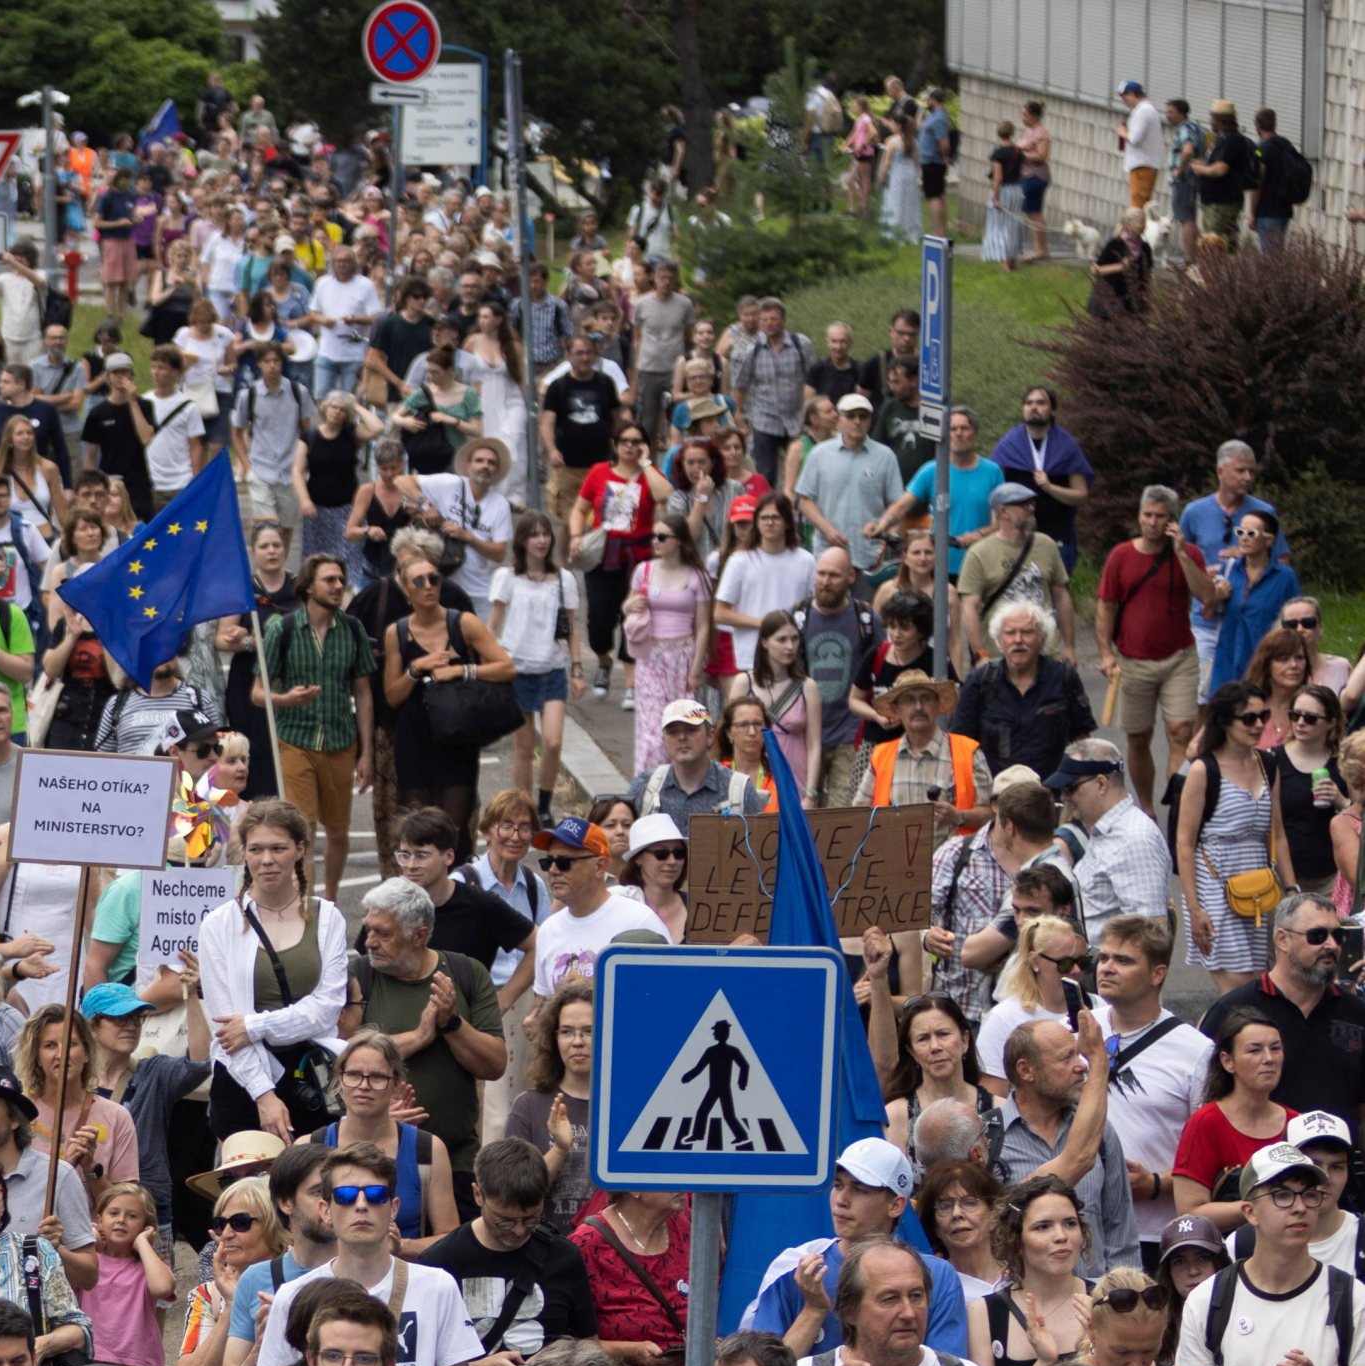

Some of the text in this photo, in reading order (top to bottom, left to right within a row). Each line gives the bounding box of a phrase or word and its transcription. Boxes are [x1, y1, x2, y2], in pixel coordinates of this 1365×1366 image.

[925, 260, 940, 347] P
[38, 776, 150, 796] NAŠEHO OTÍKA?
[81, 802, 102, 814] NA
[34, 819, 145, 837] MINISTERSTVO?
[729, 824, 923, 880] KOEC !
[152, 879, 226, 898] Nechceme
[157, 907, 197, 925] místo
[151, 933, 199, 956] Agrofe
[1178, 1220, 1193, 1234] NY
